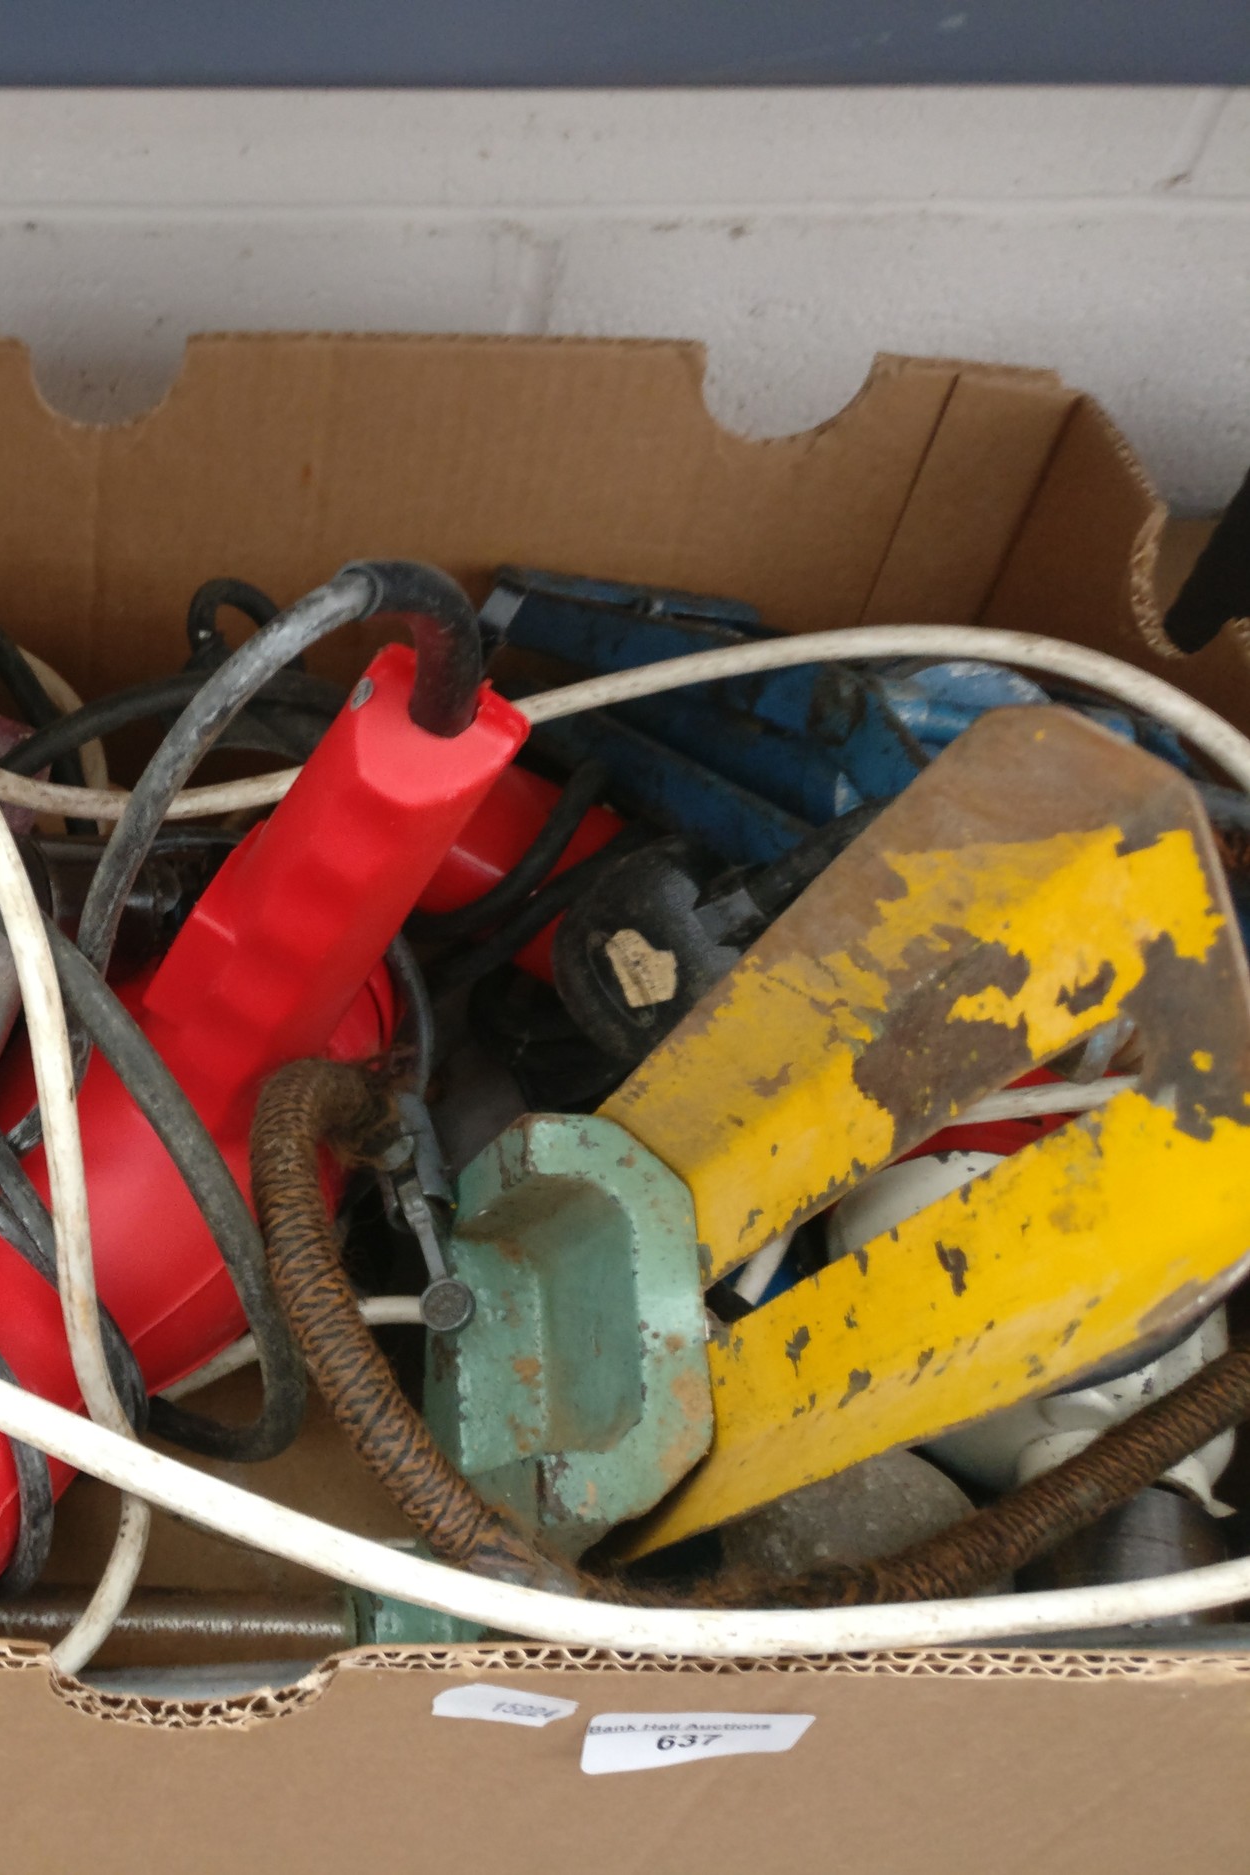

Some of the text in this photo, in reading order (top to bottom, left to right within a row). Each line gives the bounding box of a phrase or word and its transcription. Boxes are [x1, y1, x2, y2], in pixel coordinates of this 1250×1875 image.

[588, 1722, 771, 1734] Bank Hall Auctions
[656, 1734, 722, 1751] 637
